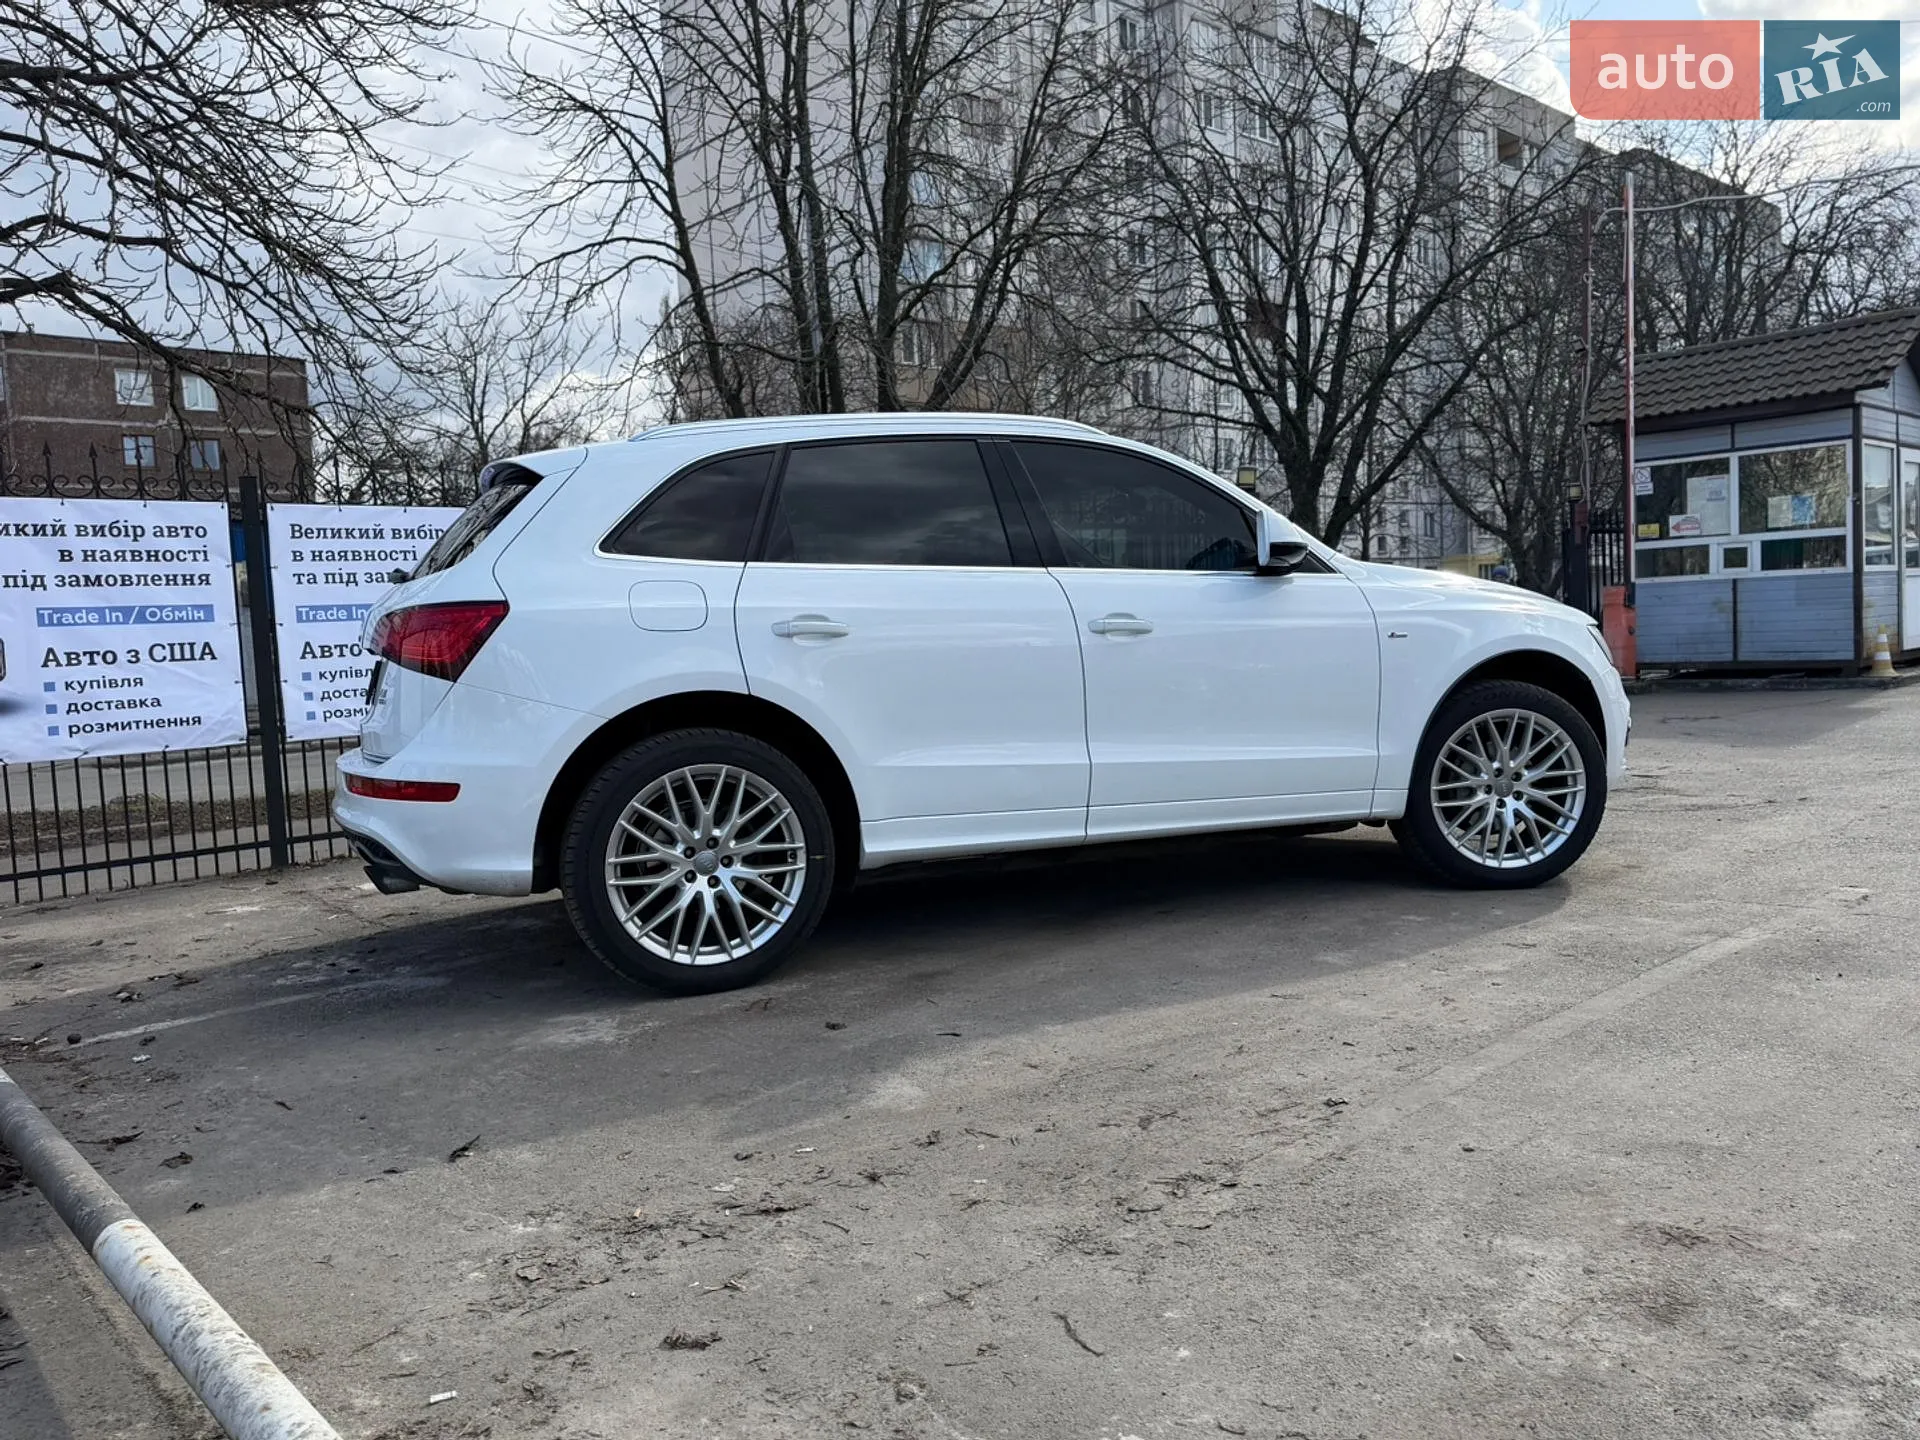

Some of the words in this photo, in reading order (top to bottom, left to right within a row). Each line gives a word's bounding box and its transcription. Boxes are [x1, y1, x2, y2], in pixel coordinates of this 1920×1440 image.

[0, 518, 67, 537] икий
[75, 520, 145, 542] вибір
[152, 525, 208, 538] авто
[289, 524, 385, 540] Великий
[58, 549, 74, 562] в
[82, 545, 210, 562] наявності
[291, 550, 304, 562] в
[311, 546, 417, 562] наявності
[2, 569, 47, 591] під
[54, 573, 211, 588] замовлення
[293, 571, 318, 585] та
[323, 568, 358, 587] під
[38, 609, 99, 625] Trade
[106, 609, 123, 623] In
[145, 607, 205, 622] Обмін
[298, 607, 345, 620] Trade
[352, 606, 367, 619] In
[41, 647, 118, 668] Авто
[126, 649, 141, 664] з
[149, 642, 218, 662] США
[299, 641, 362, 660] Авто
[319, 666, 373, 683] купівл
[64, 676, 144, 694] купівля
[320, 687, 368, 702] доста
[66, 697, 162, 715] доставка
[68, 716, 202, 738] розмитнення
